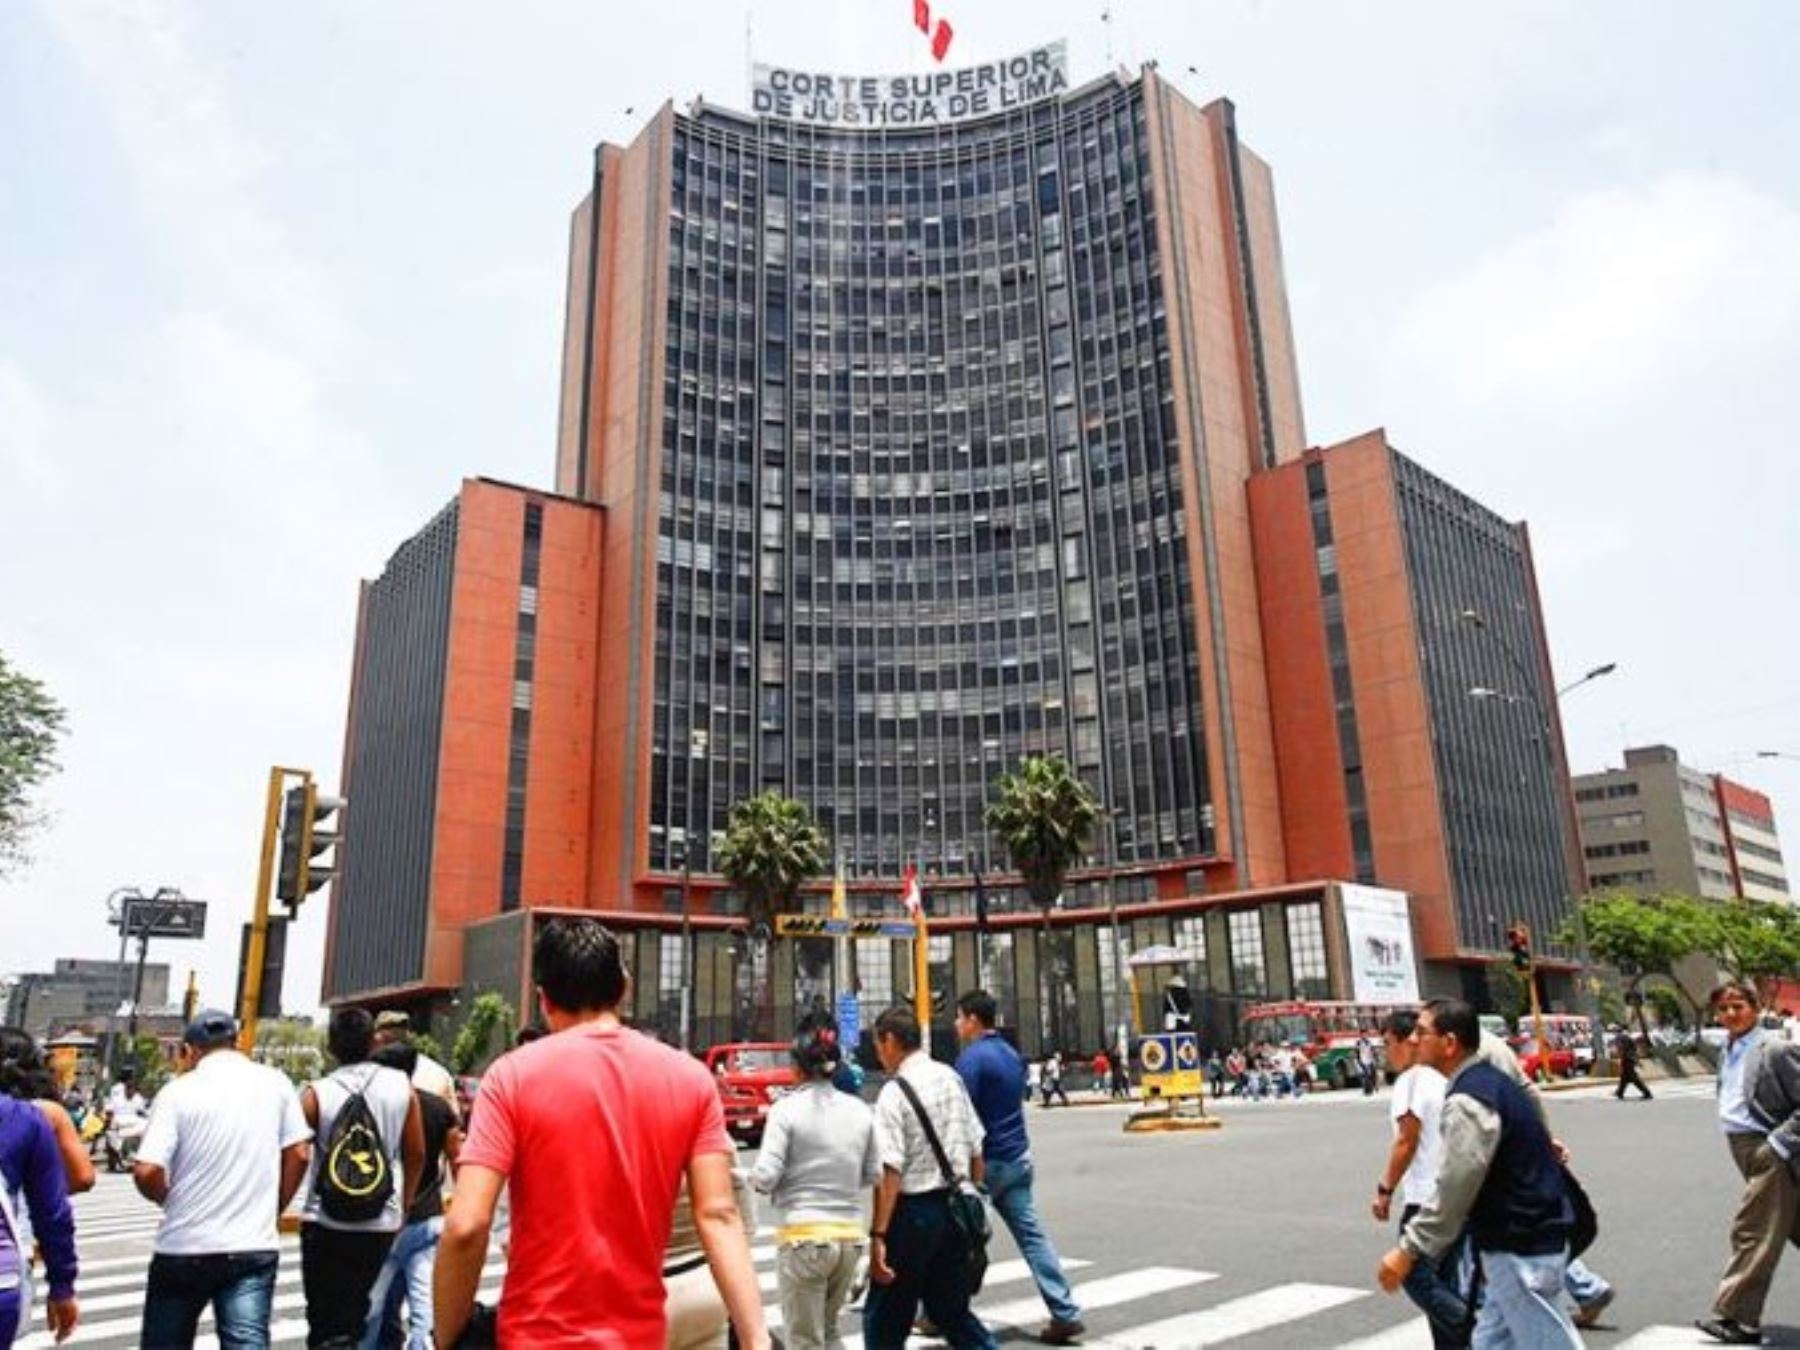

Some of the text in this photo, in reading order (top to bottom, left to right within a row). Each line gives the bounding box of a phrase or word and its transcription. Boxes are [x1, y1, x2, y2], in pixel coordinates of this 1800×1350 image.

[752, 67, 1068, 124] DE JUSTICIA DE LIMA
[769, 50, 1050, 100] CORTE SUPERIOR
